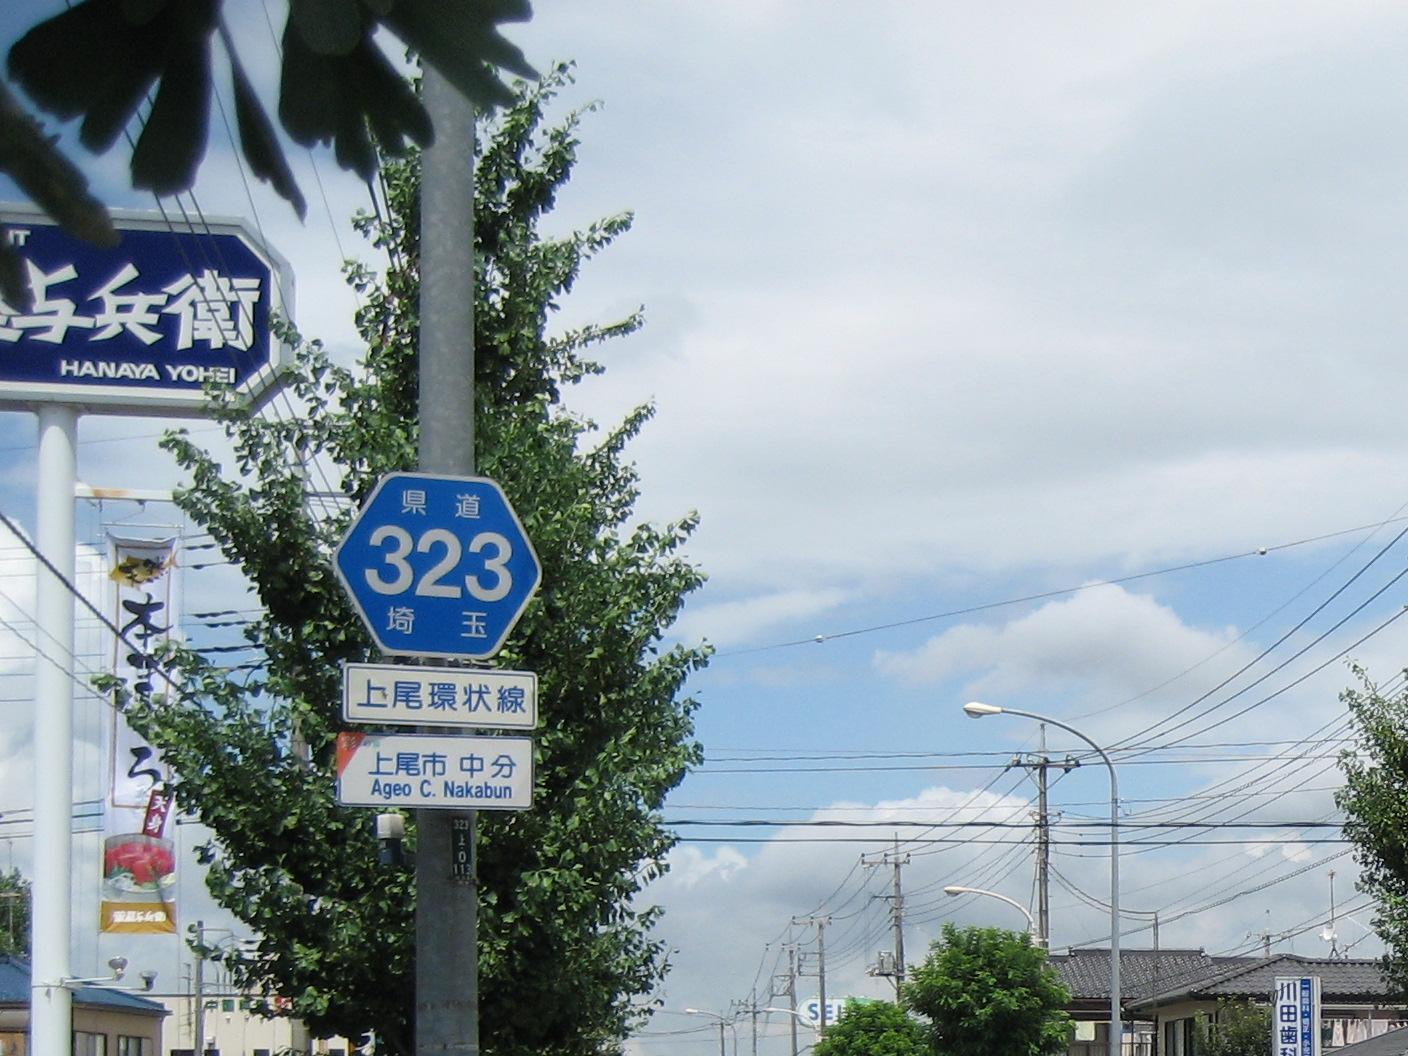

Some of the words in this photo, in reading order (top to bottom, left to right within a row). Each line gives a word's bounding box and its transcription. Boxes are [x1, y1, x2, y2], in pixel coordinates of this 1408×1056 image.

[60, 359, 160, 381] HANAYA
[165, 364, 236, 384] YOHEI
[364, 524, 513, 601] 323
[357, 679, 527, 714] 上尾環状線
[371, 779, 411, 800] Ageo
[420, 779, 436, 797] C.
[444, 781, 512, 799] Nakabun
